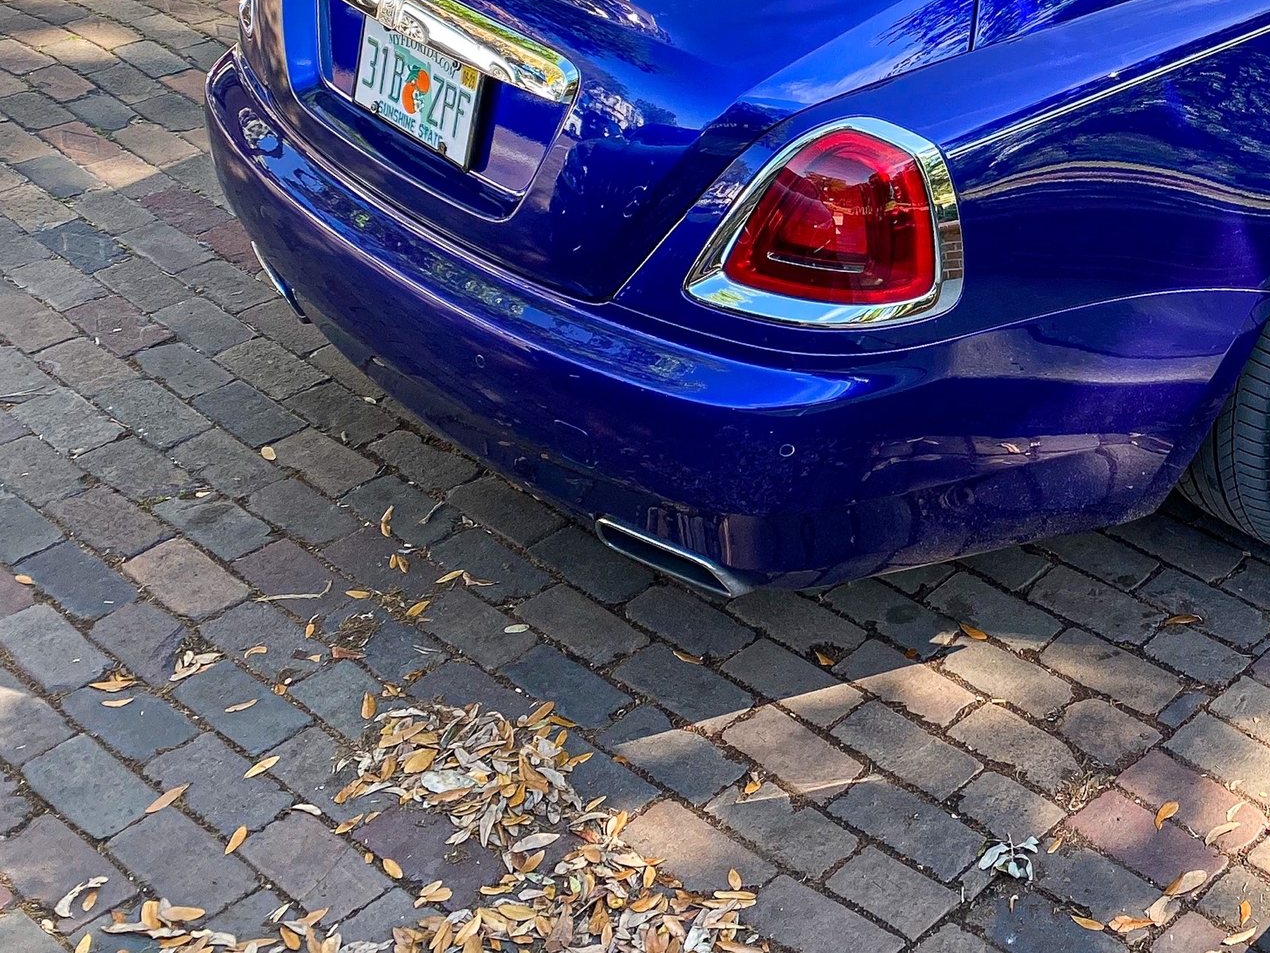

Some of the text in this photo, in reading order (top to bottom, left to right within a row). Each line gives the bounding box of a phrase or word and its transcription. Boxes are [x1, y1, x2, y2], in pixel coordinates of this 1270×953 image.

[362, 36, 472, 139] 31B ZPF
[378, 100, 417, 133] SUNSHINE
